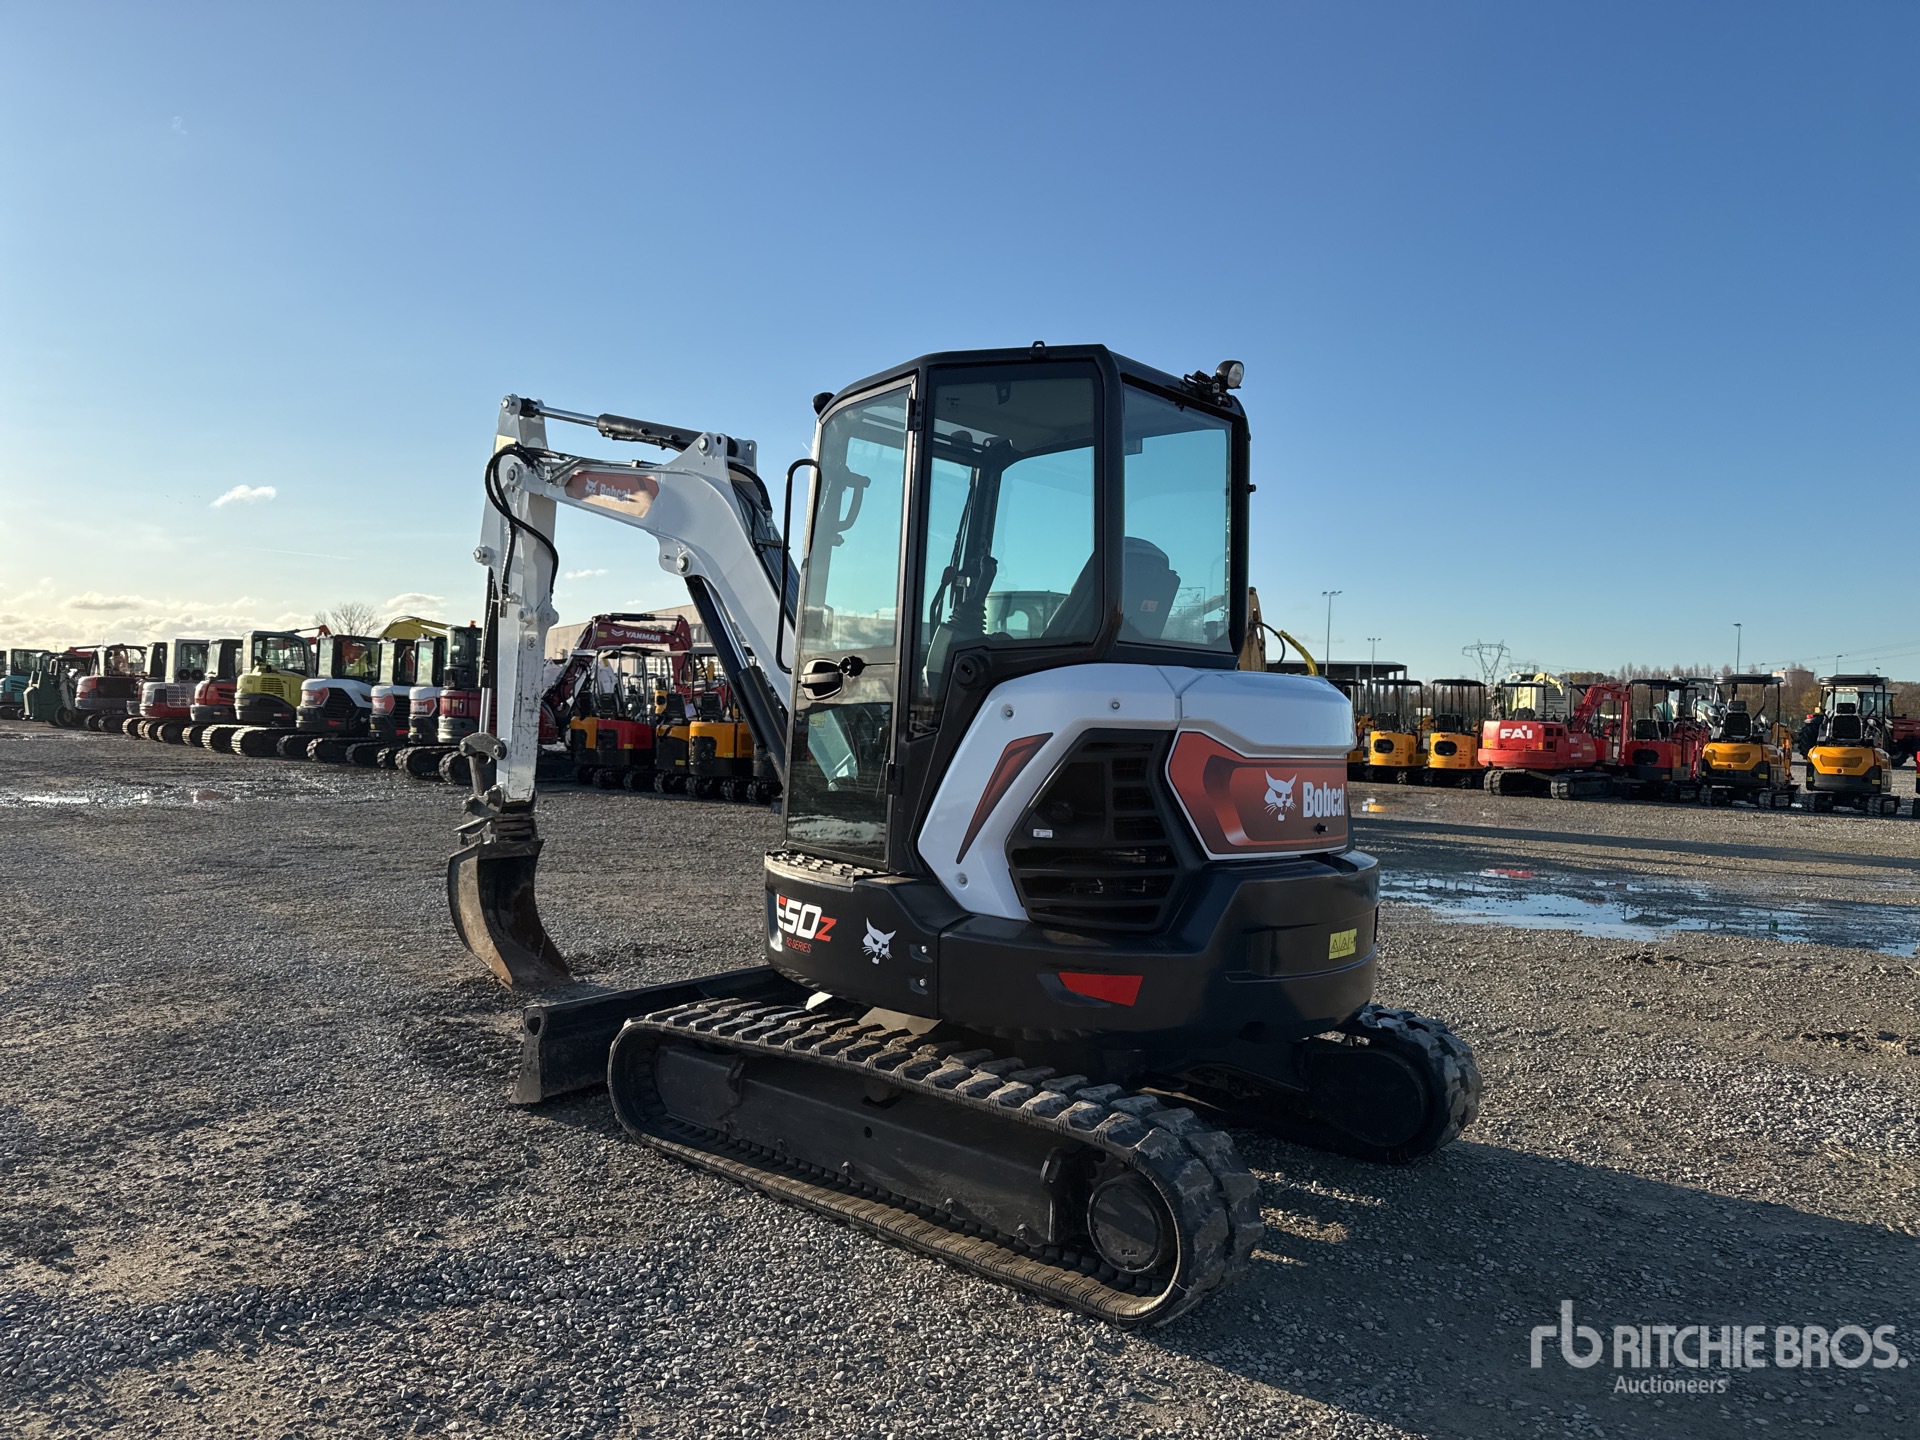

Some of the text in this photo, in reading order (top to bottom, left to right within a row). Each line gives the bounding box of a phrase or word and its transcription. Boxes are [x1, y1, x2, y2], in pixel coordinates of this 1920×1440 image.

[600, 483, 631, 503] Bobcat
[626, 631, 661, 642] YANMAR
[1302, 781, 1345, 818] Bobcat
